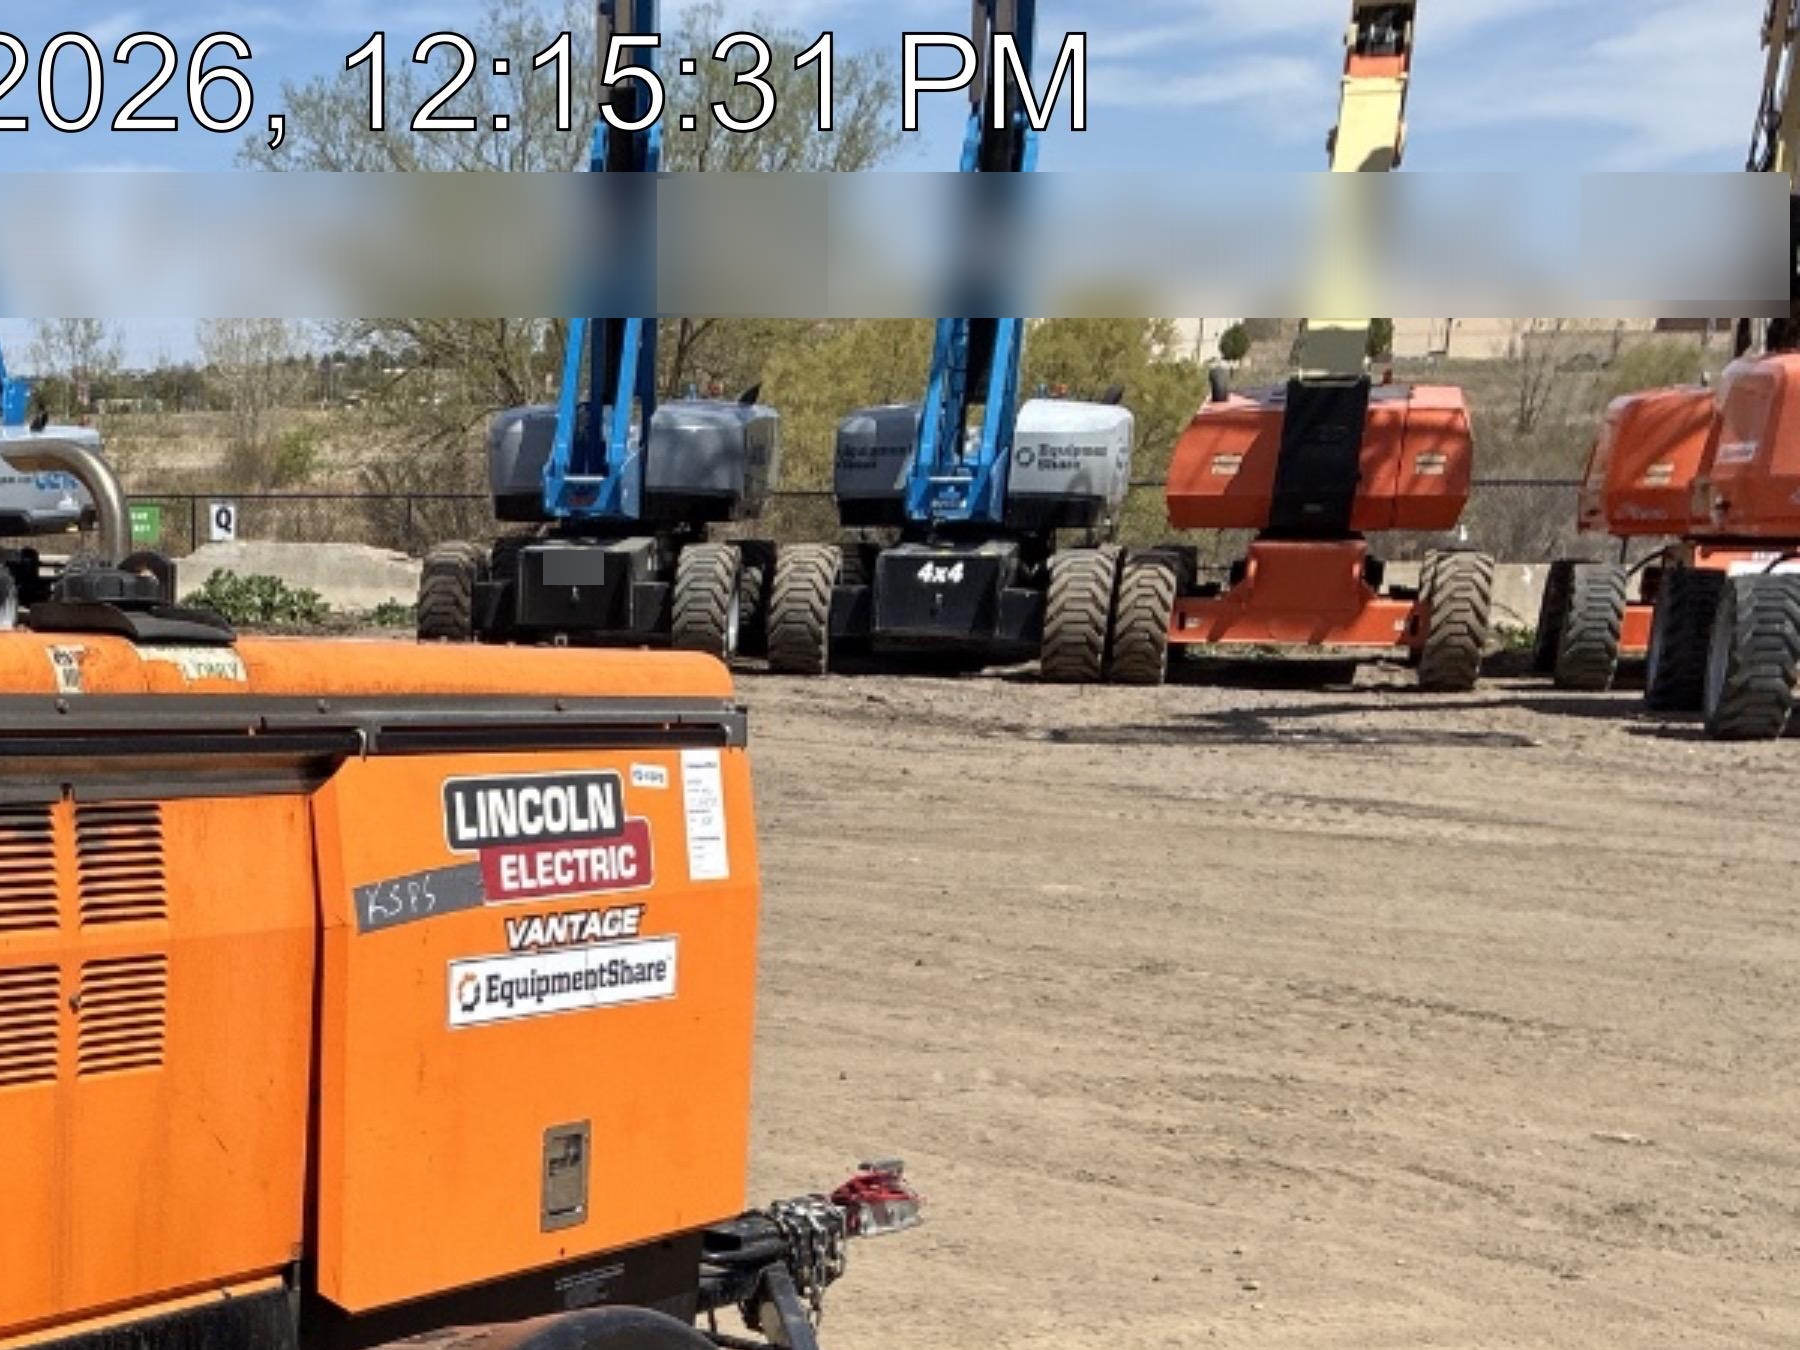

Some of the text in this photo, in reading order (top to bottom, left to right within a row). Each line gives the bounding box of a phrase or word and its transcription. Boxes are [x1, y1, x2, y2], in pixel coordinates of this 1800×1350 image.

[216, 508, 232, 534] Q
[917, 561, 965, 583] 4x4
[455, 782, 616, 841] LINCOLN
[500, 844, 637, 892] ELECTRIC
[505, 905, 643, 952] VANTAGE
[485, 957, 668, 1008] EquipmentShare
